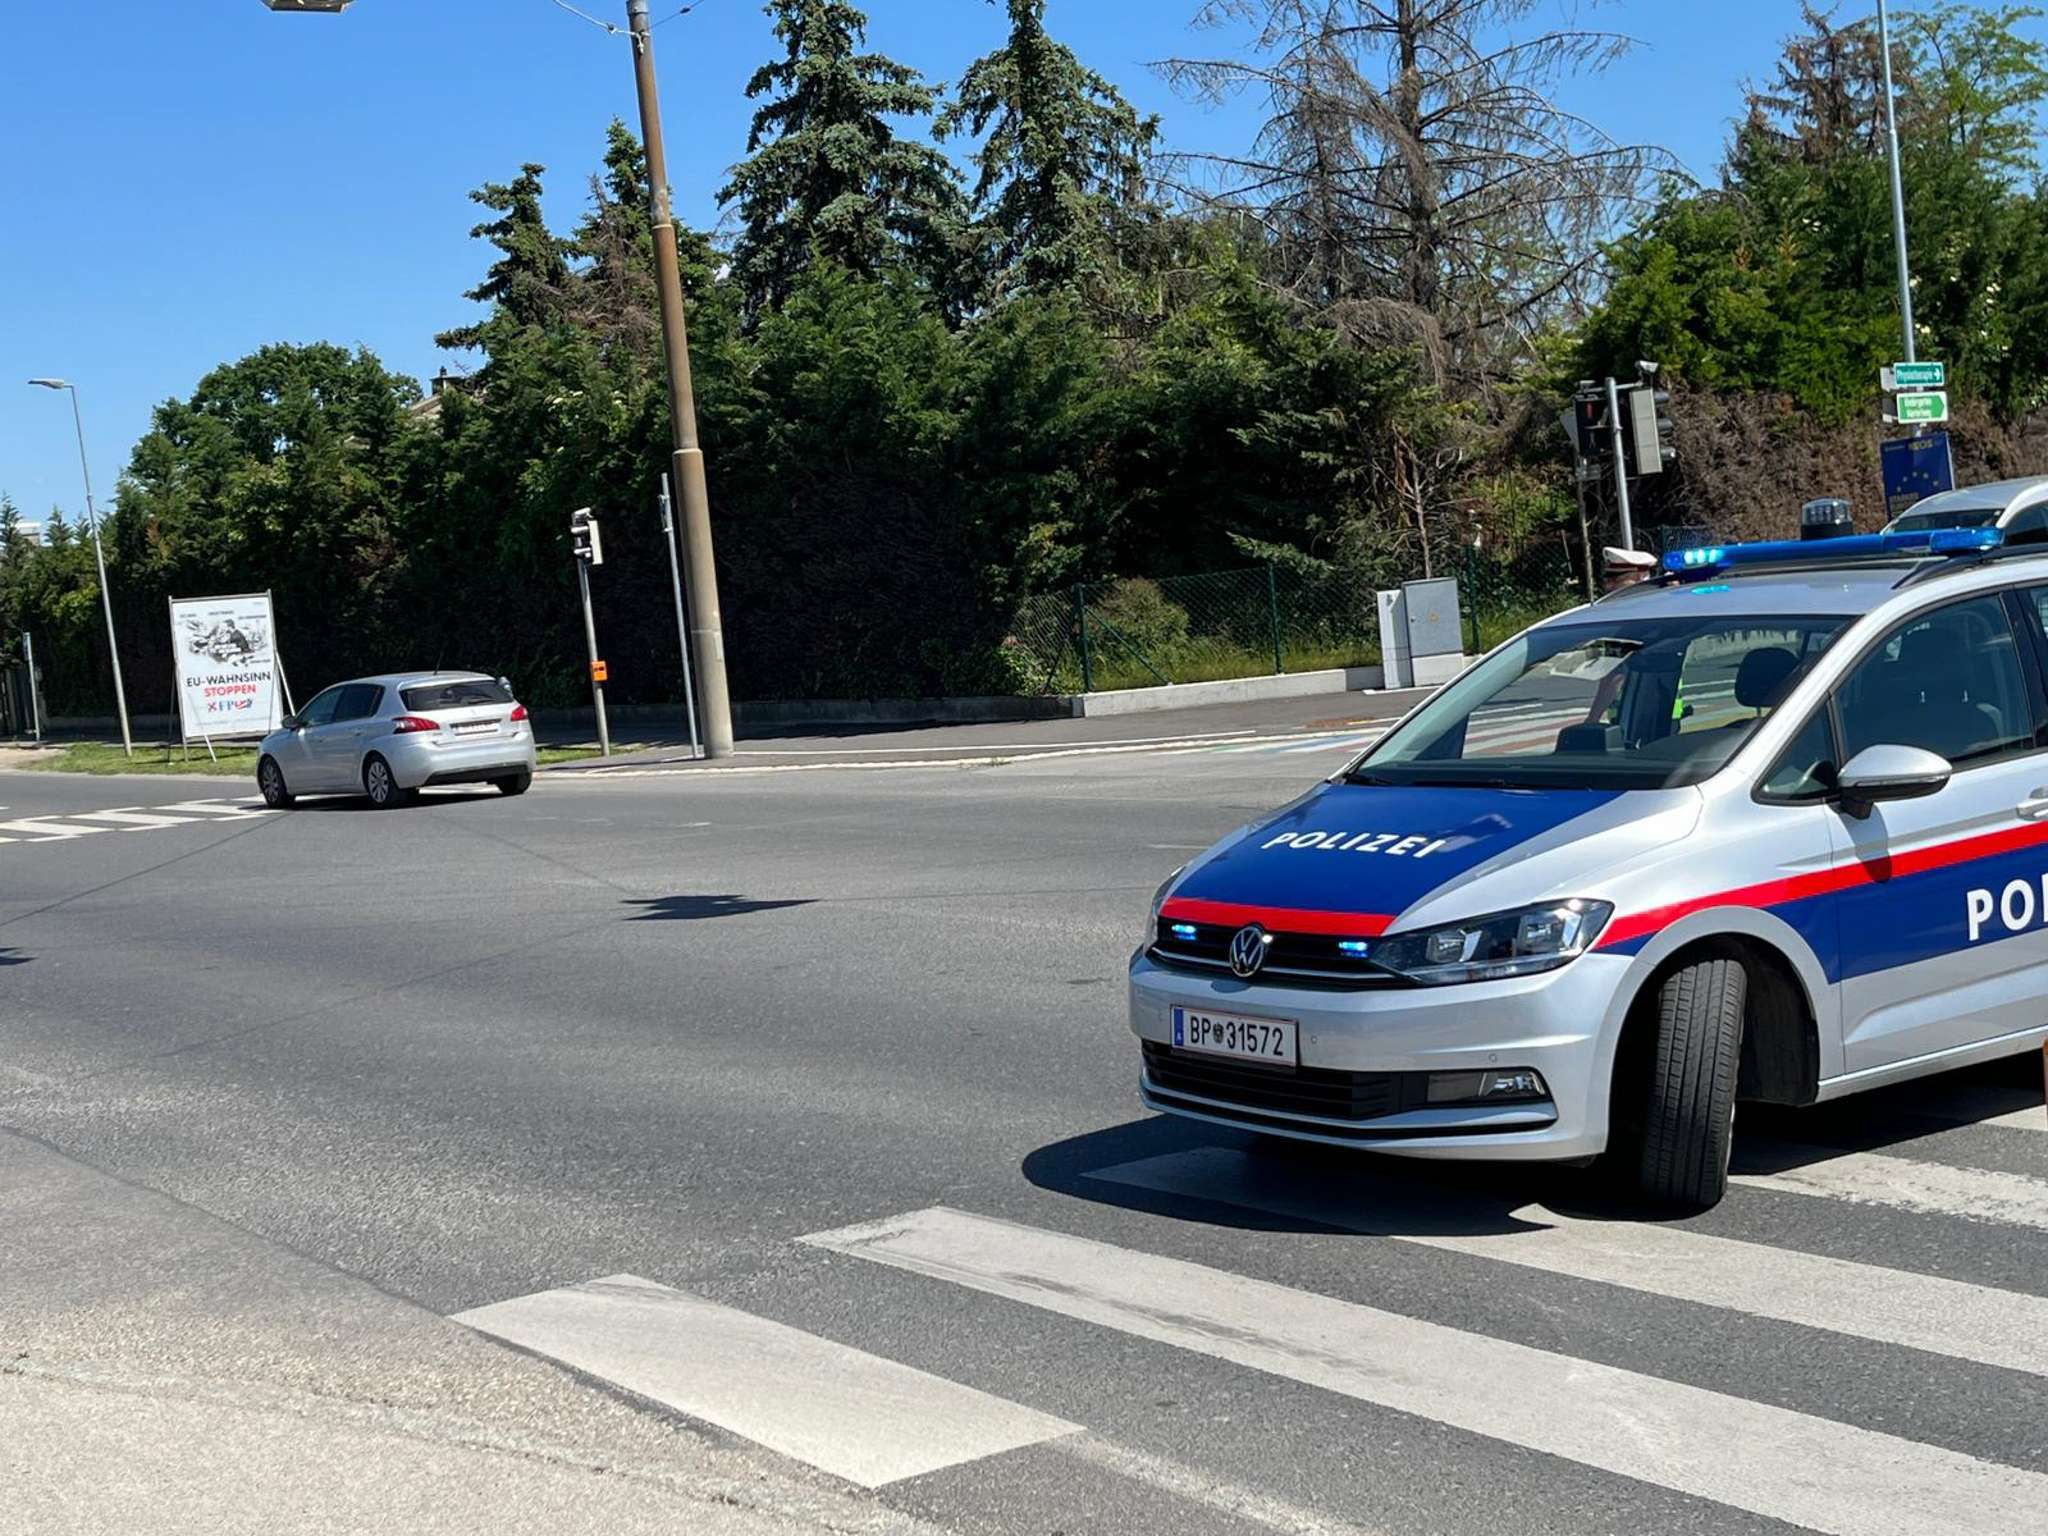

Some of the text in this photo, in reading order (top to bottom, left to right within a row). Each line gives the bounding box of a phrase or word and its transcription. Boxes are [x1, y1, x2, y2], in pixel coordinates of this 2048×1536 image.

[186, 671, 271, 687] EU-WAHNSINN
[204, 684, 256, 697] STOPPEN
[1261, 831, 1447, 858] POLIZEI
[1190, 1016, 1284, 1056] BP 31572
